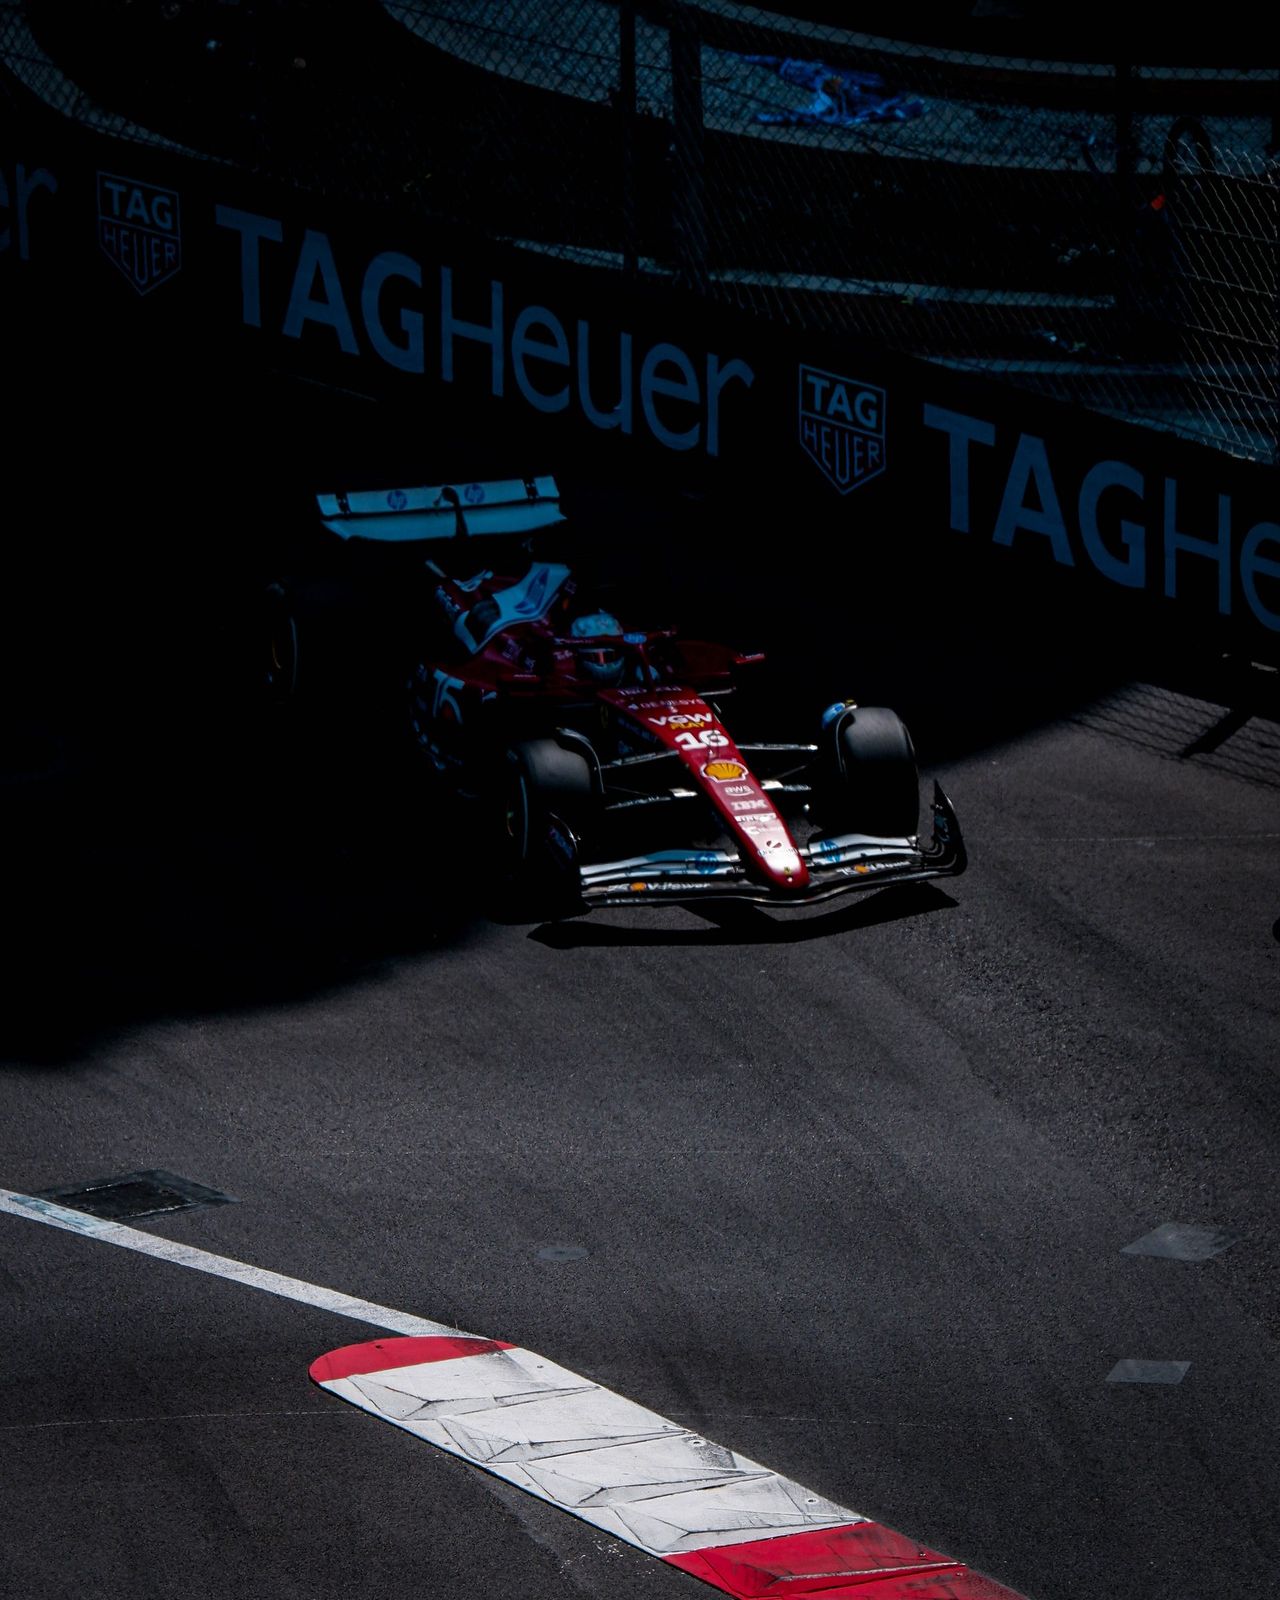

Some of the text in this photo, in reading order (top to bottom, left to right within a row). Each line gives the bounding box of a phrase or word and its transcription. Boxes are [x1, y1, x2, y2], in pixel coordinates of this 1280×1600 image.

[0, 161, 59, 262] r
[103, 181, 173, 230] TAG
[103, 224, 176, 285] HEUER
[805, 374, 878, 429] TAG
[803, 419, 881, 485] HEUER
[648, 713, 712, 726] VGW
[674, 730, 729, 750] 16
[724, 785, 752, 796] aws
